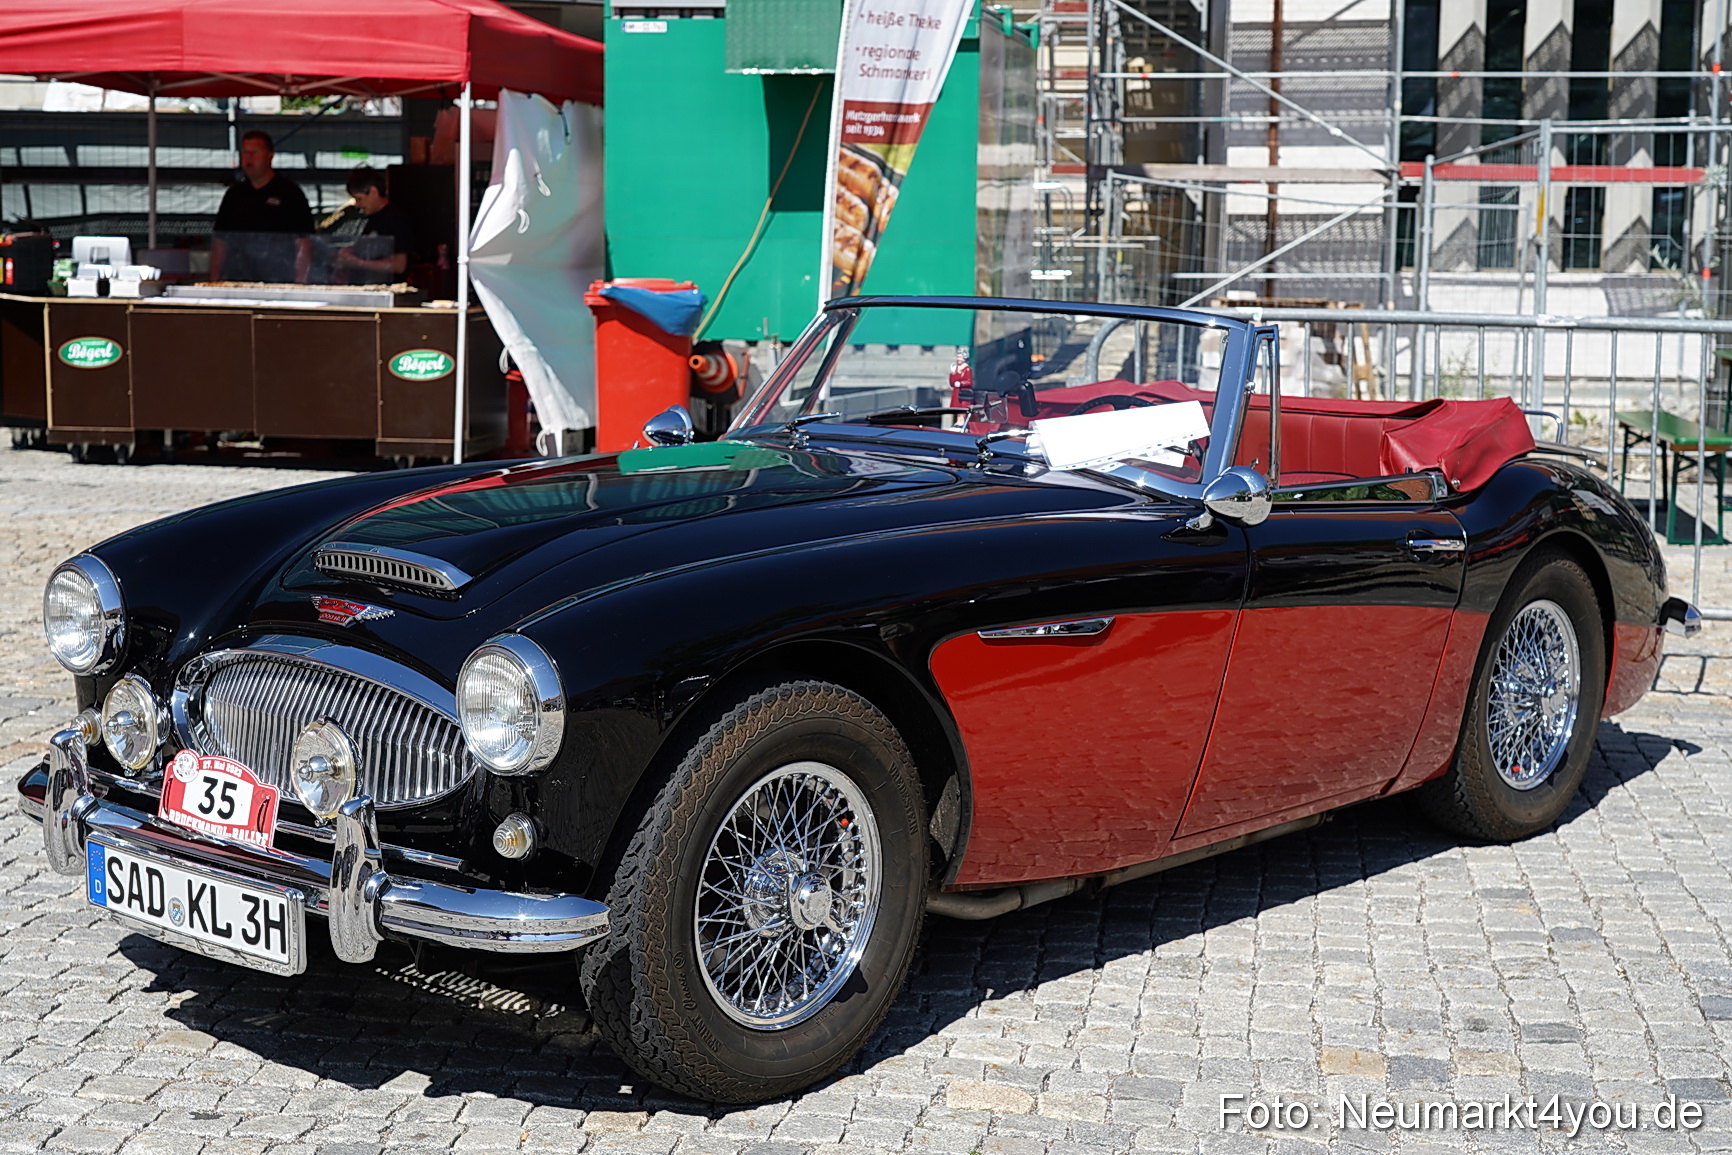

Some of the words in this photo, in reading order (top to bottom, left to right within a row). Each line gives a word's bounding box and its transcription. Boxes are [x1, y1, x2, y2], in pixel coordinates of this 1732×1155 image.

[866, 11, 904, 28] heiße
[908, 13, 942, 29] Theke
[197, 775, 238, 820] 35
[888, 761, 918, 835] VREDESTEIN
[94, 880, 102, 894] D
[107, 856, 165, 918] SAD
[187, 878, 233, 939] KL
[241, 893, 287, 955] 3H
[678, 971, 698, 1011] Classic
[692, 1014, 724, 1052] SPRINT
